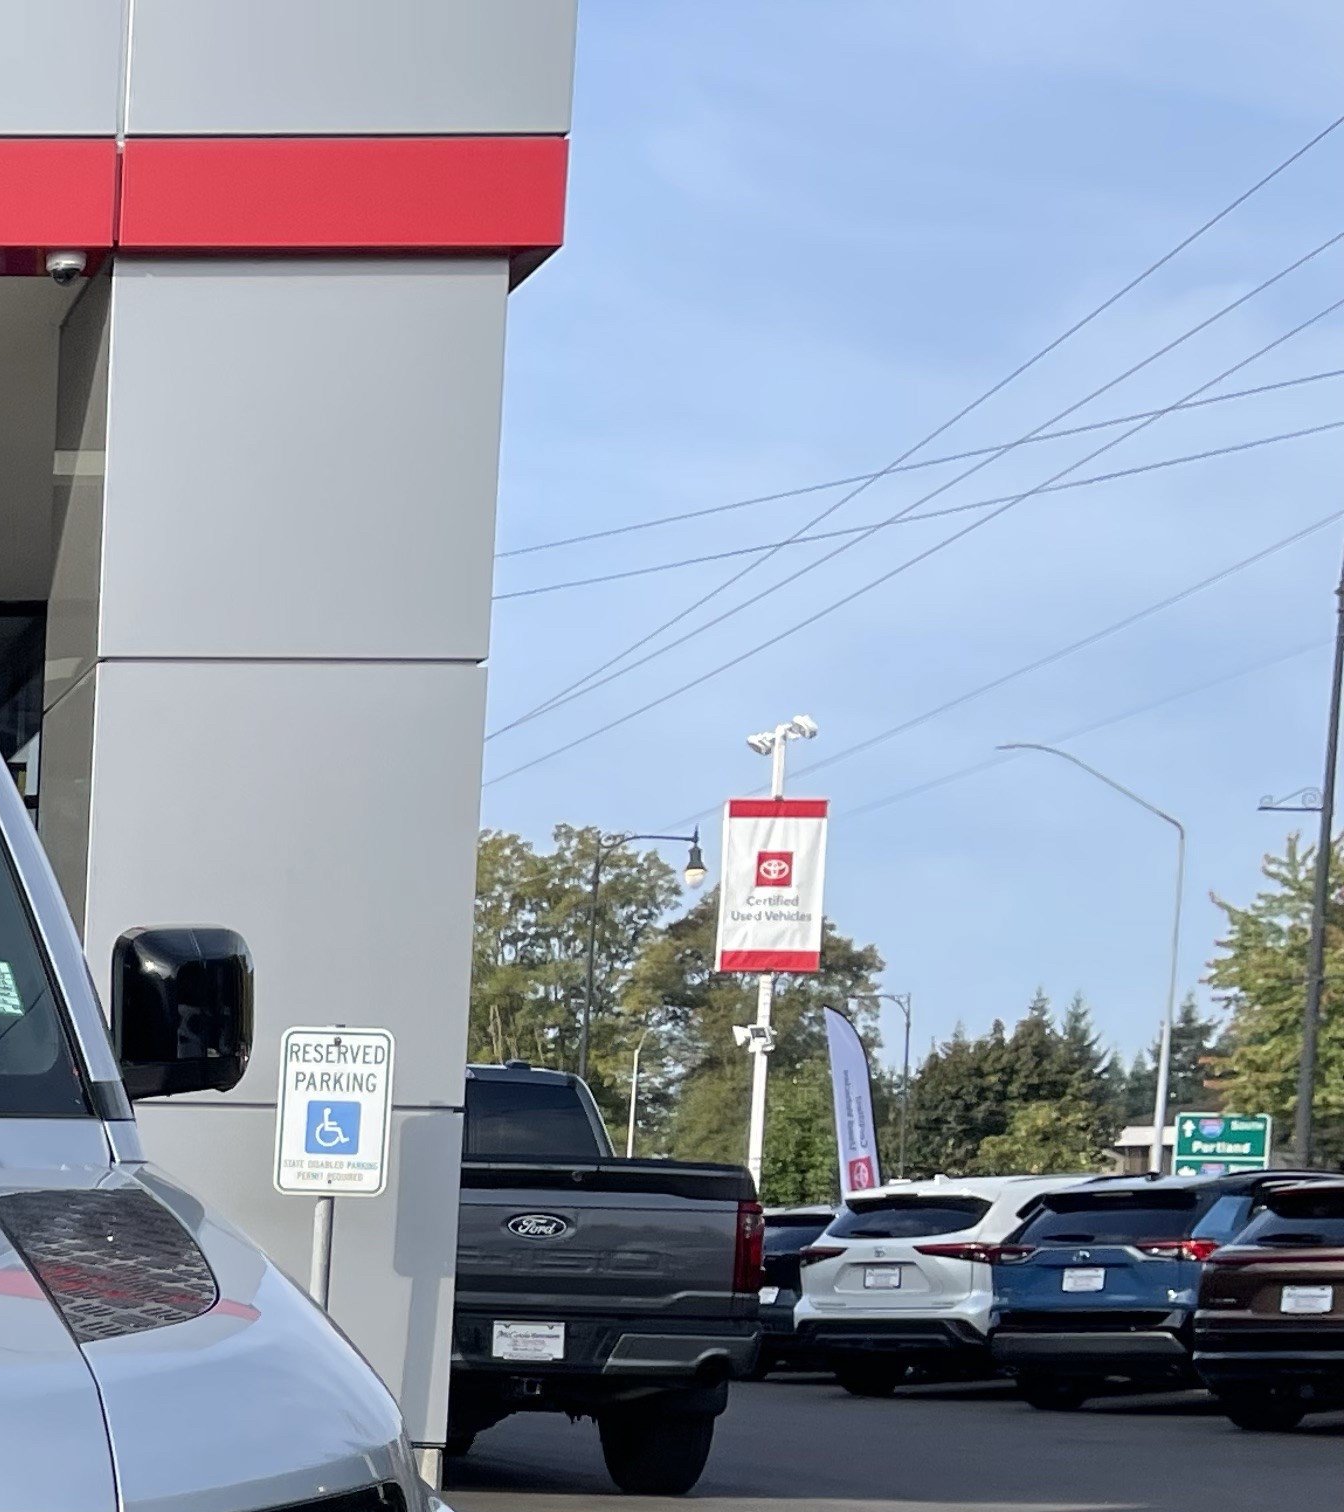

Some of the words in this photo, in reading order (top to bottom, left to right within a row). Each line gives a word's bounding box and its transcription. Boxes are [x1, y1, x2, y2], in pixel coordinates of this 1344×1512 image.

[745, 894, 800, 907] Certified
[730, 910, 762, 921] Used
[764, 910, 812, 922] Vehicles
[289, 1043, 386, 1065] RESERVED
[294, 1071, 378, 1093] PARKING
[518, 1215, 557, 1234] Ford
